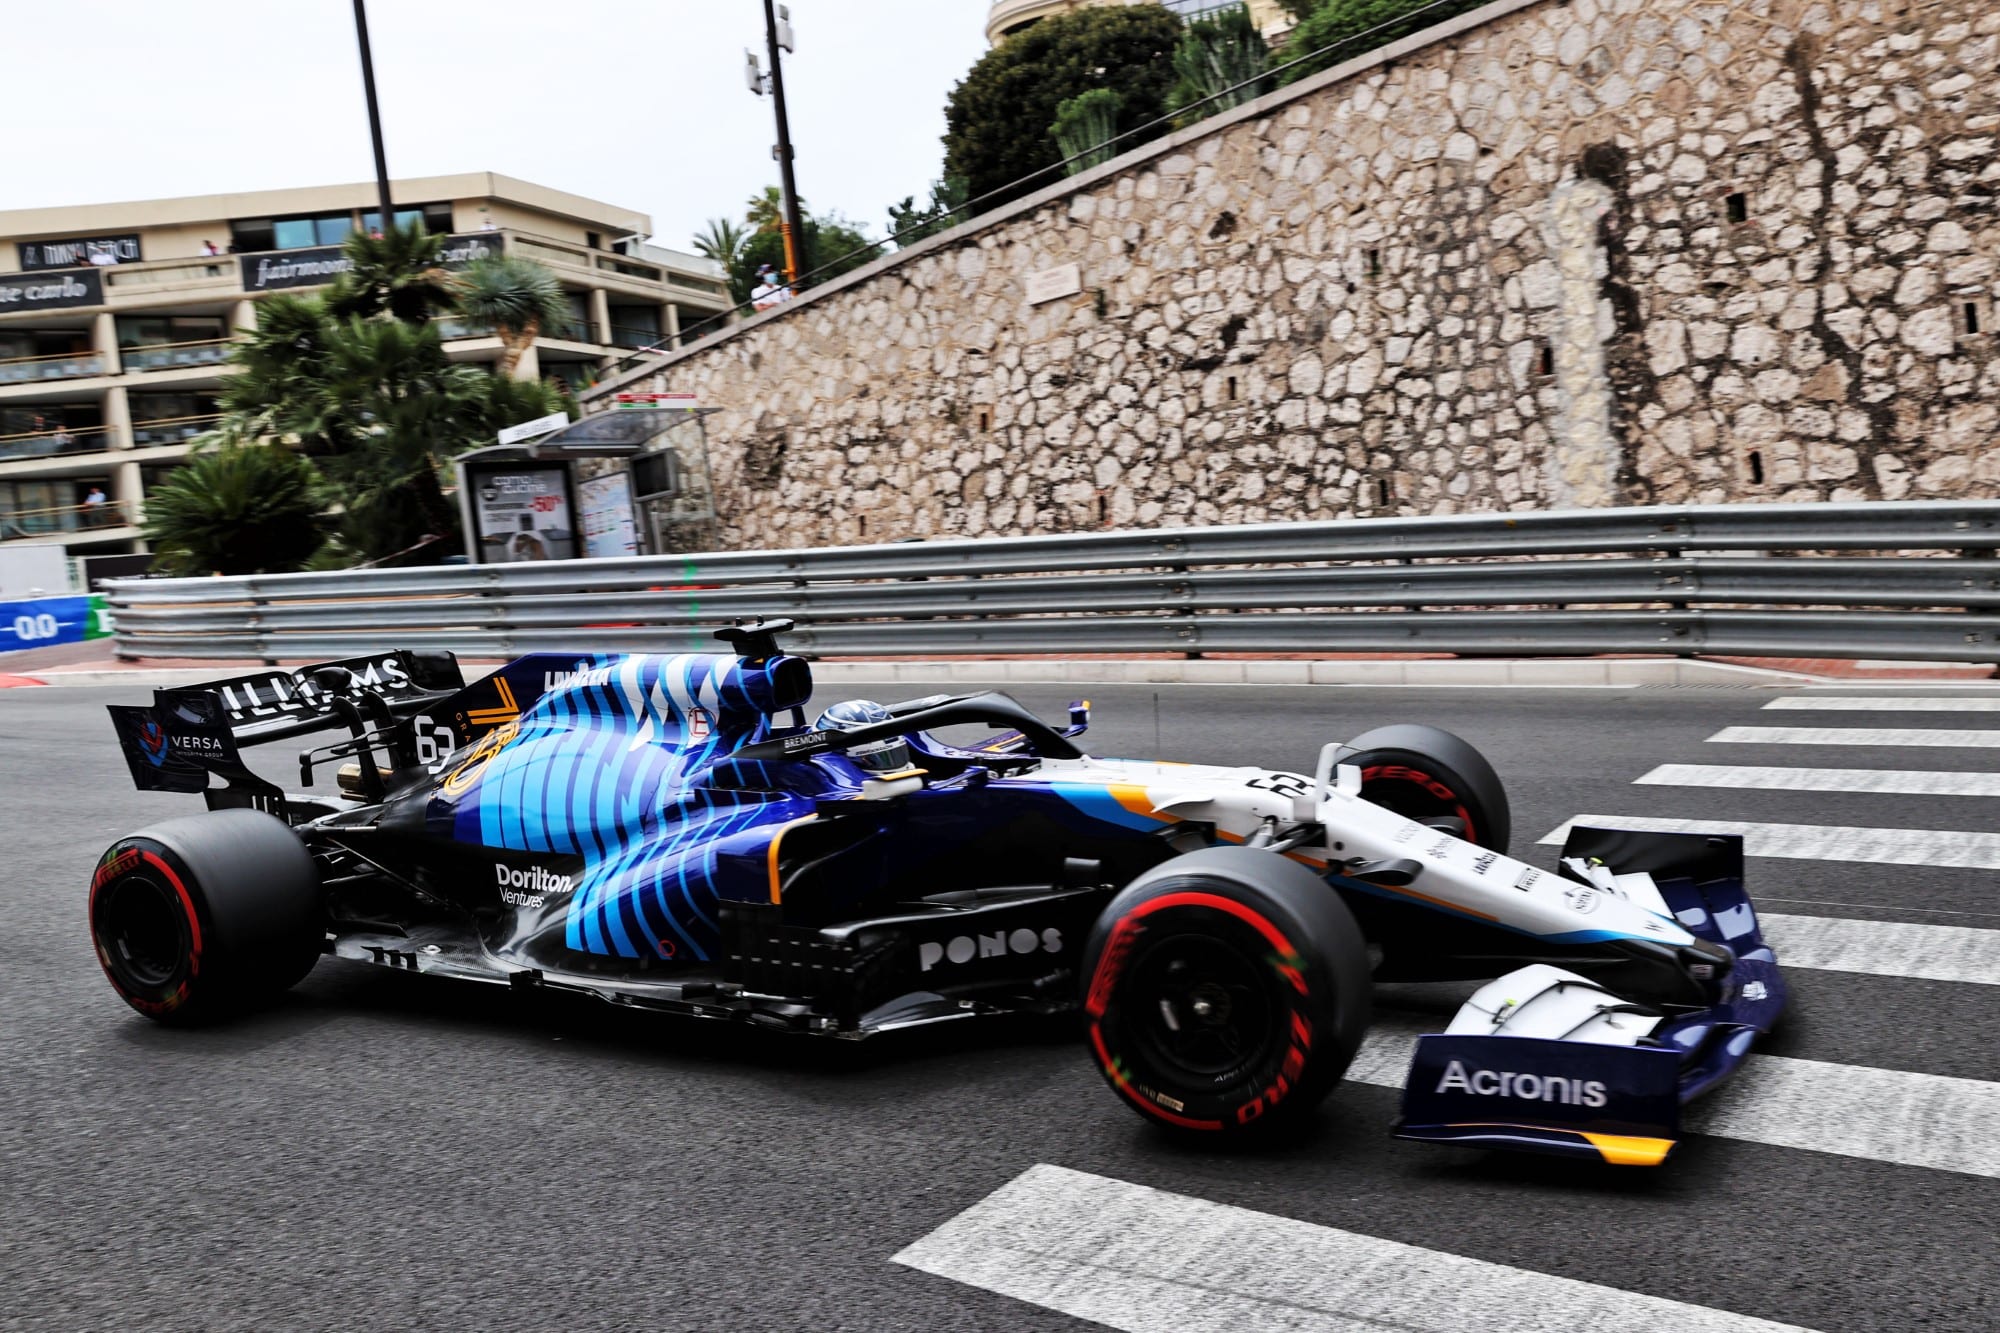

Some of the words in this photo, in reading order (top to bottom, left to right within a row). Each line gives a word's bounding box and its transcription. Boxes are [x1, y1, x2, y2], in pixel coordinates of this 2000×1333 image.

[24, 275, 88, 301] carlo
[171, 735, 223, 750] VERSA
[413, 714, 457, 775] 63
[784, 731, 828, 749] BREMONT
[498, 886, 545, 909] Ventures
[919, 926, 1063, 972] PONOS
[1435, 1059, 1608, 1108] Acronis
